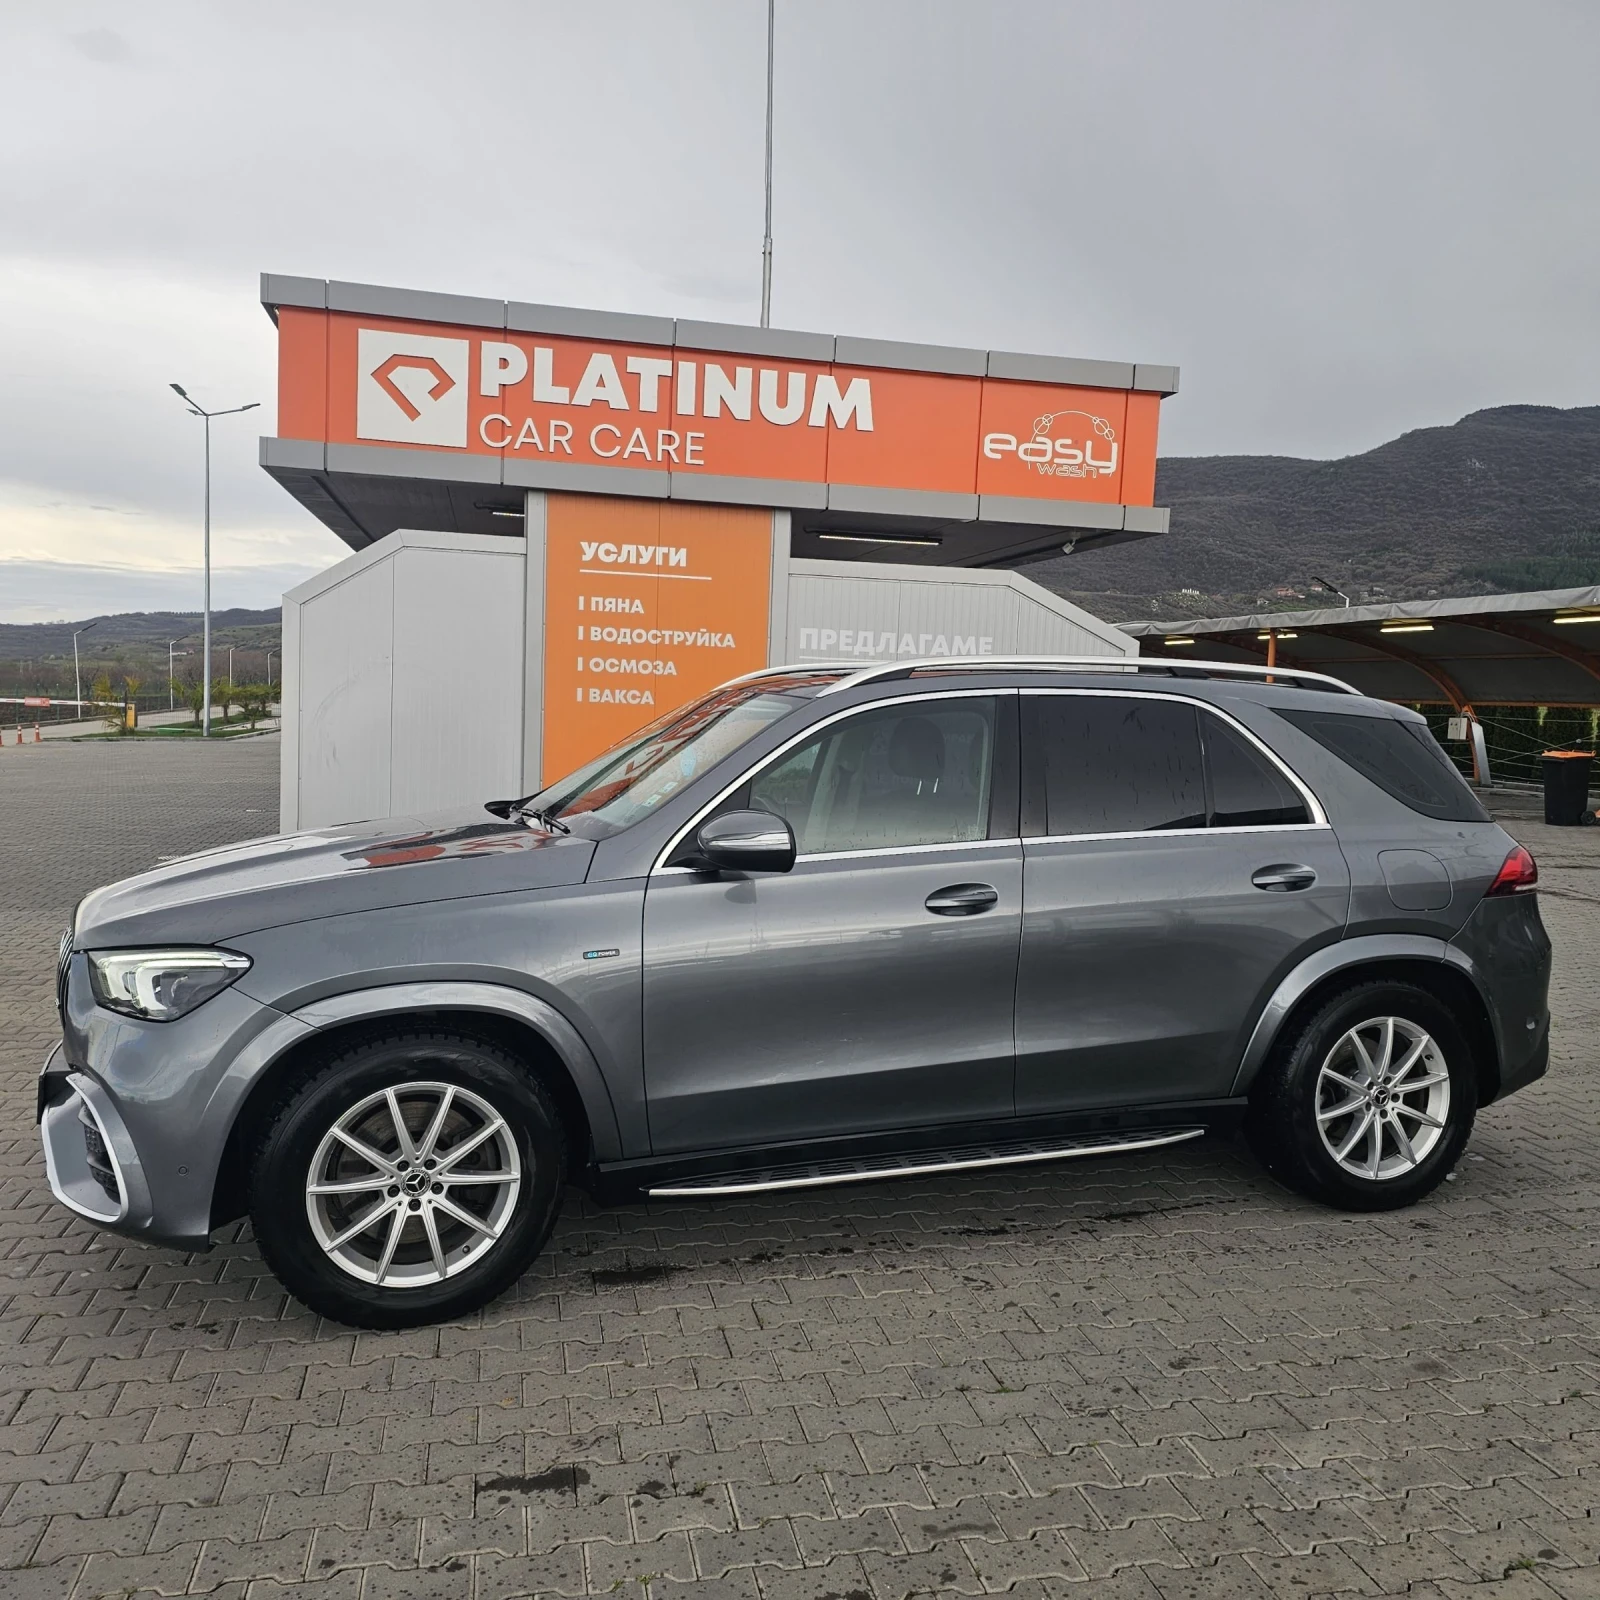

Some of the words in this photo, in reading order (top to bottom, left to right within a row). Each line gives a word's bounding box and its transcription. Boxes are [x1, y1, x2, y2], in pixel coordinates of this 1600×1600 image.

[480, 340, 874, 432] PLATINUM
[479, 413, 574, 455] CAR
[589, 423, 705, 466] CARE
[984, 433, 1118, 474] easy
[1036, 463, 1097, 479] wash
[580, 541, 687, 567] УСЛУГИ
[590, 596, 645, 614] ПЯНА
[590, 626, 736, 648] ВОДОСТРУЙКА
[799, 627, 994, 656] ПРЕДЛАГАМЕ
[589, 656, 677, 676] ОСМОЗА
[589, 688, 655, 705] ВАКСА
